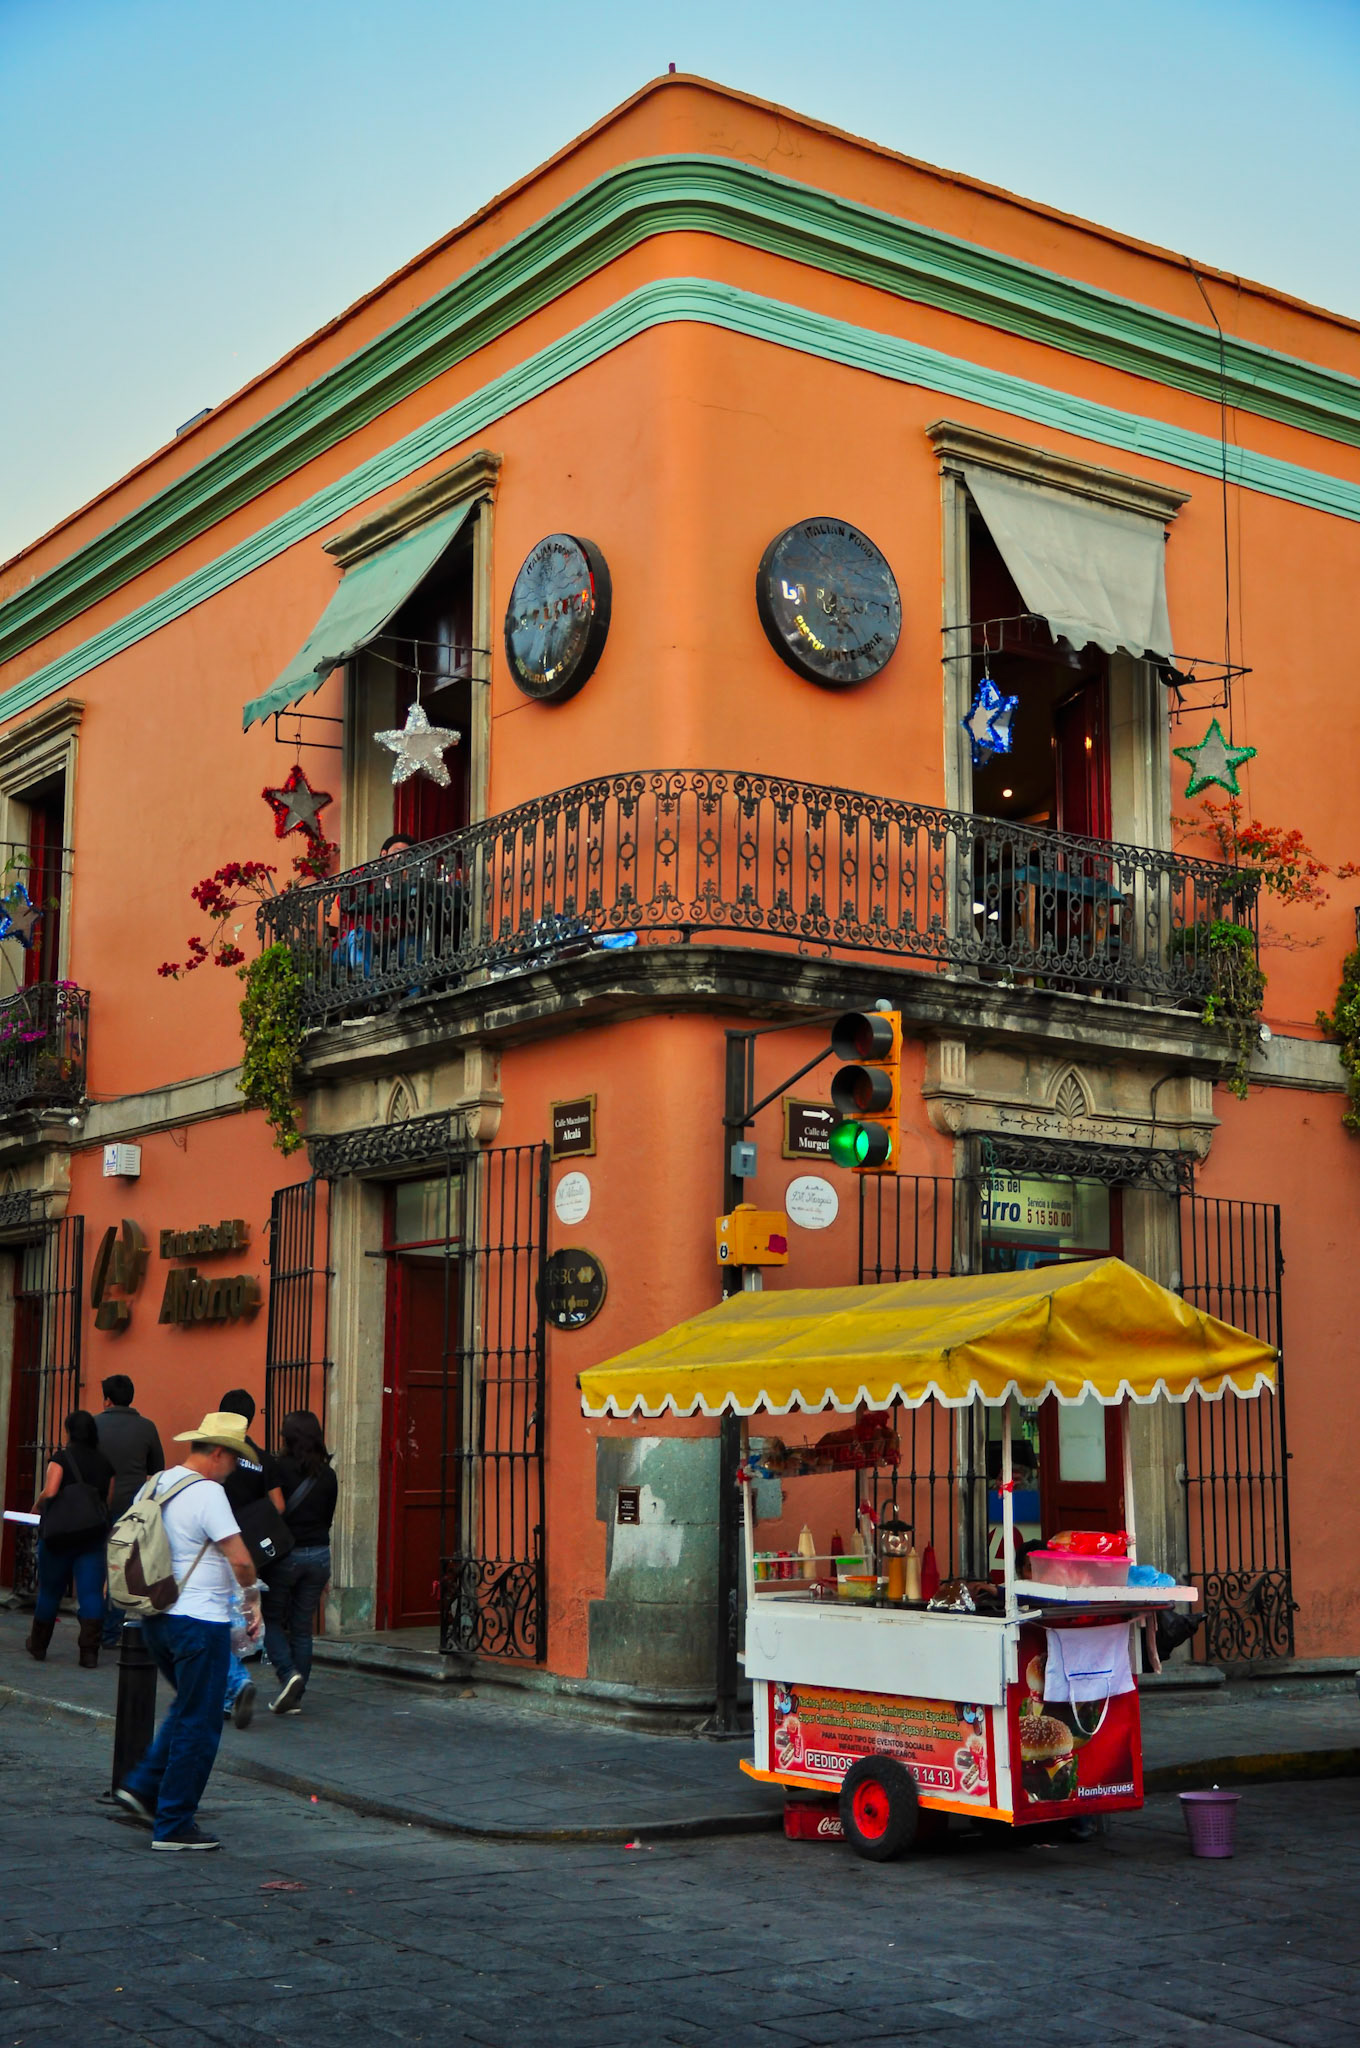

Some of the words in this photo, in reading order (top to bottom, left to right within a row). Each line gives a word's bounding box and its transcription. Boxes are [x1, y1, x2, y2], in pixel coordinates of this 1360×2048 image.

[804, 524, 845, 538] ITALIAN
[848, 533, 873, 558] FOOD
[526, 543, 551, 575] ITALIAN
[555, 1119, 566, 1128] Calle
[804, 1127, 820, 1136] Calle
[820, 1128, 829, 1137] de
[562, 1128, 582, 1141] Alcalá
[798, 1137, 830, 1152] Murguí
[1007, 1179, 1021, 1193] del
[1027, 1197, 1046, 1208] Servicio
[1027, 1209, 1033, 1224] 5
[1035, 1210, 1046, 1225] 15
[1048, 1211, 1059, 1226] 50
[1061, 1212, 1072, 1228] 00
[158, 1267, 256, 1325] Ahorro
[799, 1696, 820, 1710] Nachos,
[845, 1701, 880, 1717] Banderillas,
[880, 1704, 924, 1720] Hamburguesas
[925, 1710, 960, 1726] Especiales,
[798, 1712, 815, 1725] Super
[815, 1714, 852, 1729] Combinadas,
[852, 1717, 881, 1731] Refrescos
[900, 1723, 920, 1737] Papas
[932, 1726, 963, 1741] Francesa.
[821, 1731, 836, 1739] PARA
[838, 1733, 853, 1741] TODO
[854, 1735, 867, 1744] TIPO
[876, 1737, 904, 1748] EVENTOS
[904, 1741, 935, 1753] SOCIALES,
[839, 1743, 870, 1753] INFANTILES
[807, 1752, 852, 1770] PEDIDOS
[913, 1767, 920, 1781] 3
[922, 1769, 935, 1783] 14
[937, 1771, 950, 1785] 13
